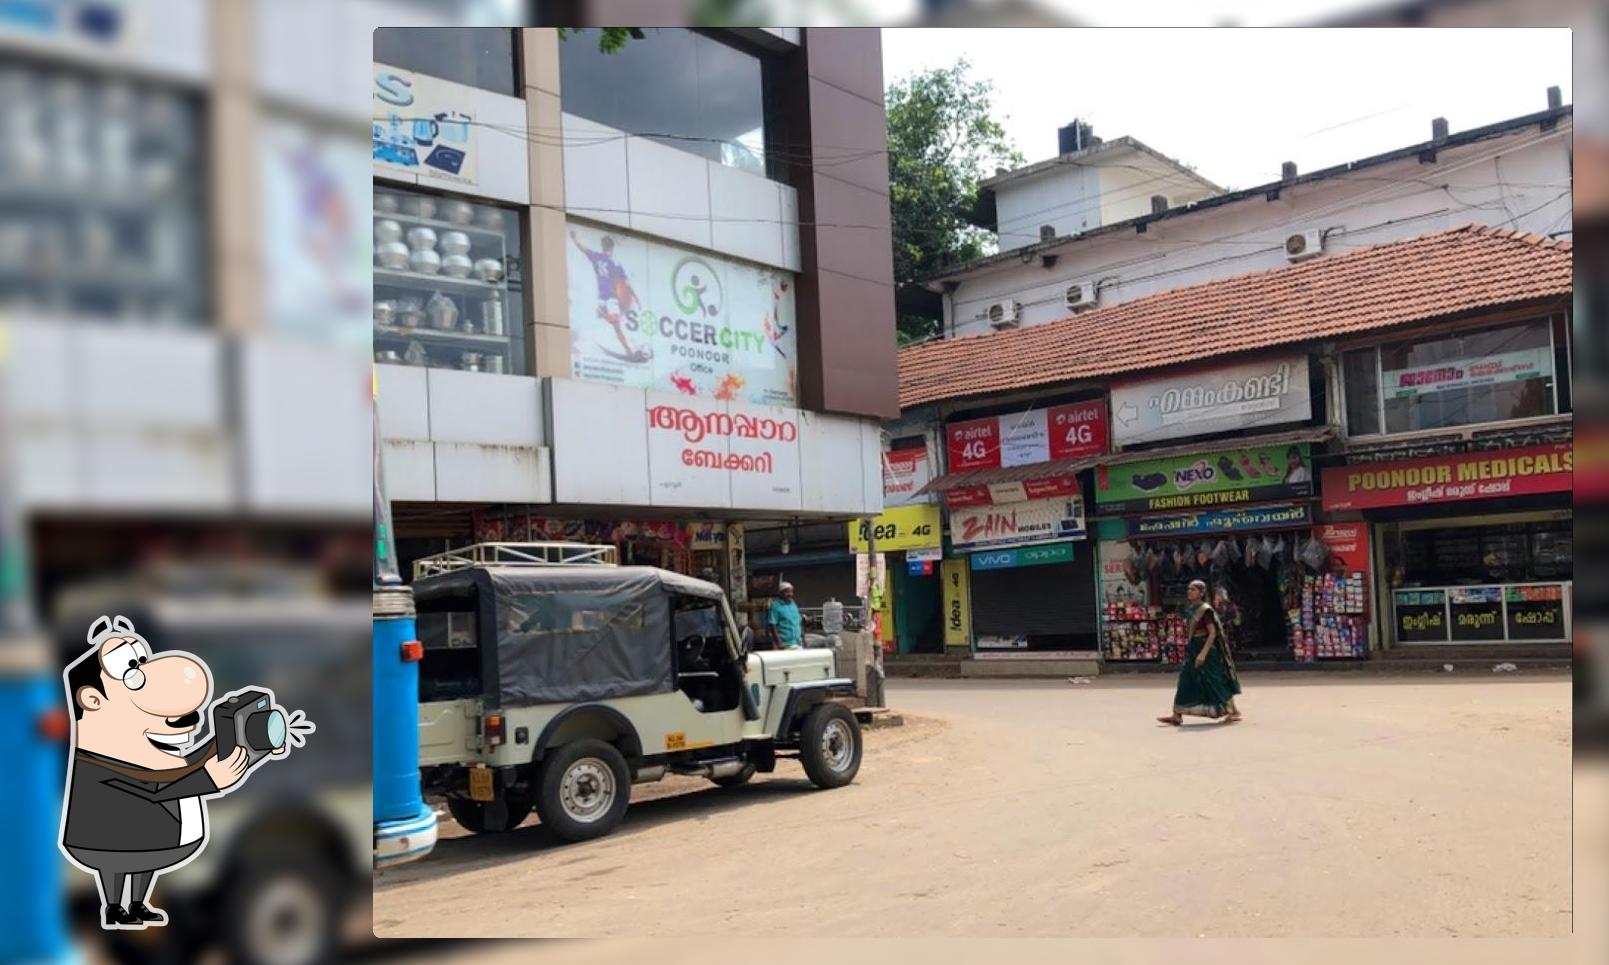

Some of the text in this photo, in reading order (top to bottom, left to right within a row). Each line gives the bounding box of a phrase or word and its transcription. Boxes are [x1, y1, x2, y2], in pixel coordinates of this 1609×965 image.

[624, 309, 765, 353] SOCCER CITY
[670, 344, 730, 364] POONOOR
[689, 362, 714, 374] Office
[646, 405, 797, 442] ആനപ്പാറ
[1068, 408, 1099, 424] airtel
[964, 425, 992, 440] airtel
[1065, 424, 1092, 445] 4G
[962, 440, 986, 459] 4G
[681, 448, 772, 474] ബേക്കറി
[1175, 466, 1214, 482] NEXO
[1348, 452, 1572, 491] POONOOR MEDICALS
[1149, 490, 1249, 508] FASHION FOOTWEAR
[912, 524, 931, 537] 4G
[962, 509, 1016, 540] ZAIN
[1025, 548, 1066, 559] oppo
[951, 573, 959, 587] 4G
